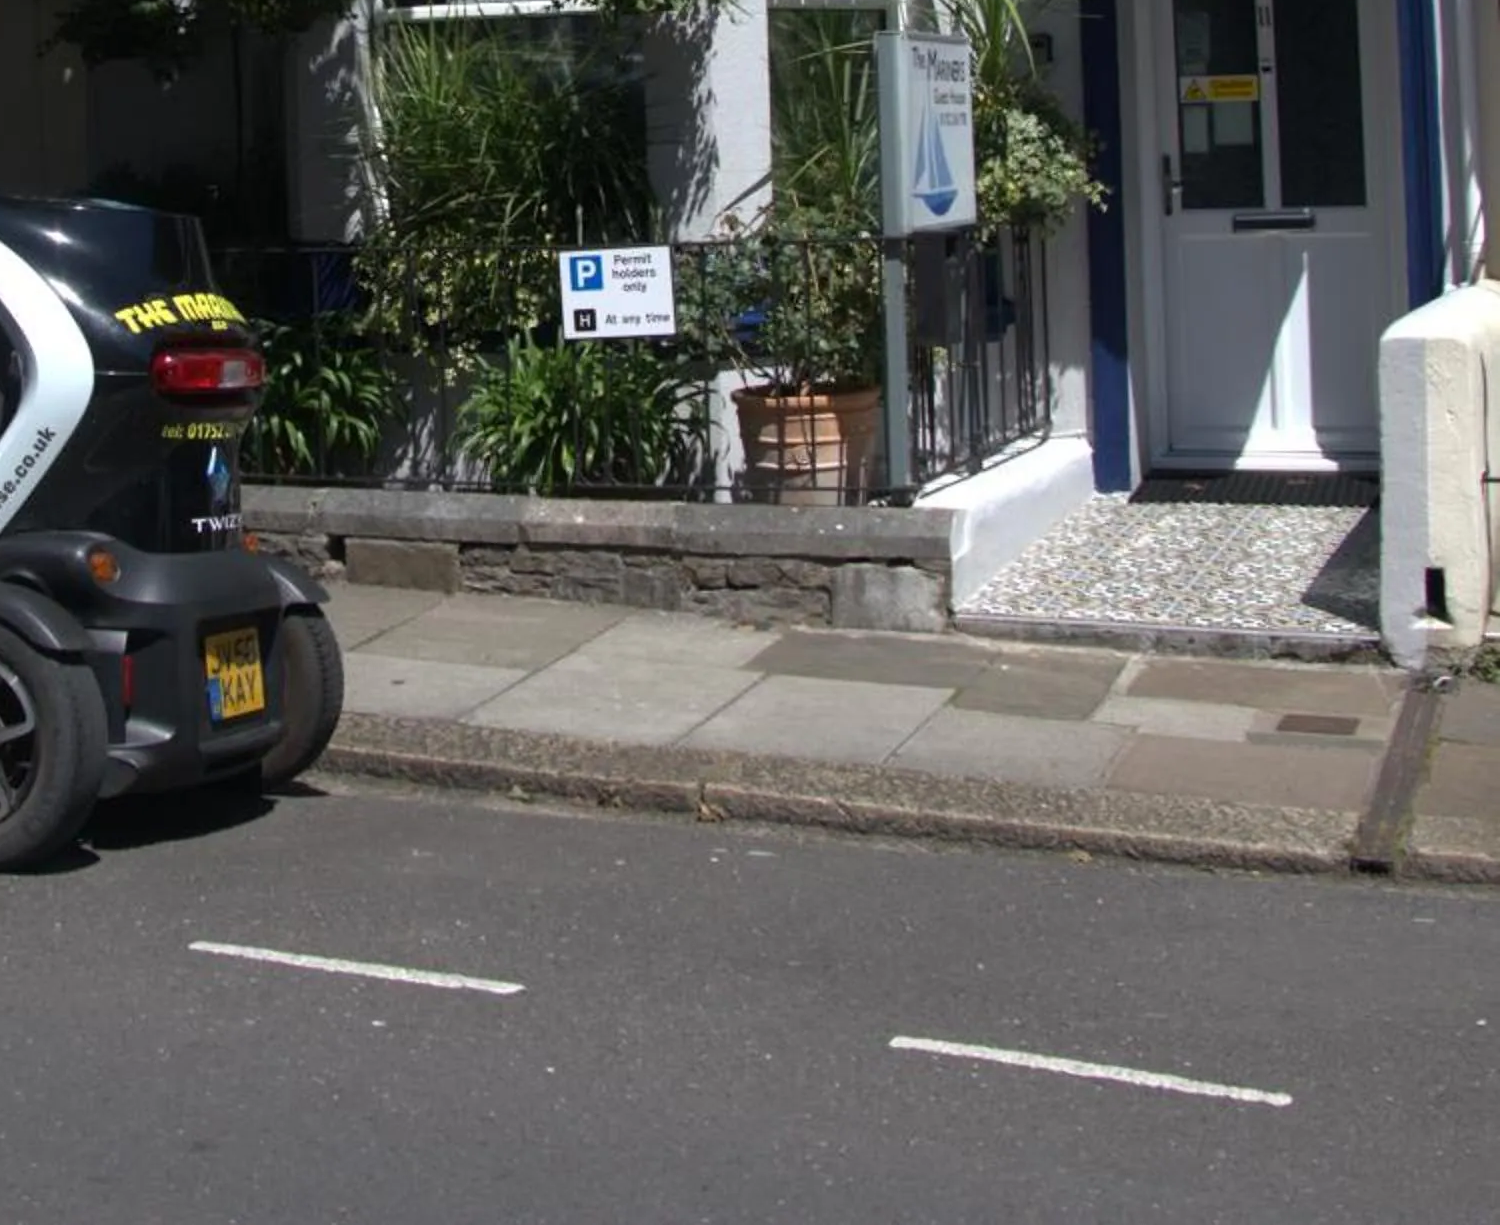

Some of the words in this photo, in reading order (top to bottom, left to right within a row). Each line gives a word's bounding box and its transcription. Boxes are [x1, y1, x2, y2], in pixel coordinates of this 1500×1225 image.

[613, 254, 652, 265] Permit
[576, 259, 597, 288] P
[611, 268, 657, 280] holders
[623, 282, 648, 294] only
[114, 300, 178, 334] THE
[605, 314, 617, 325] At
[622, 315, 641, 327] any
[645, 313, 671, 324] time
[223, 667, 257, 713] KAY
